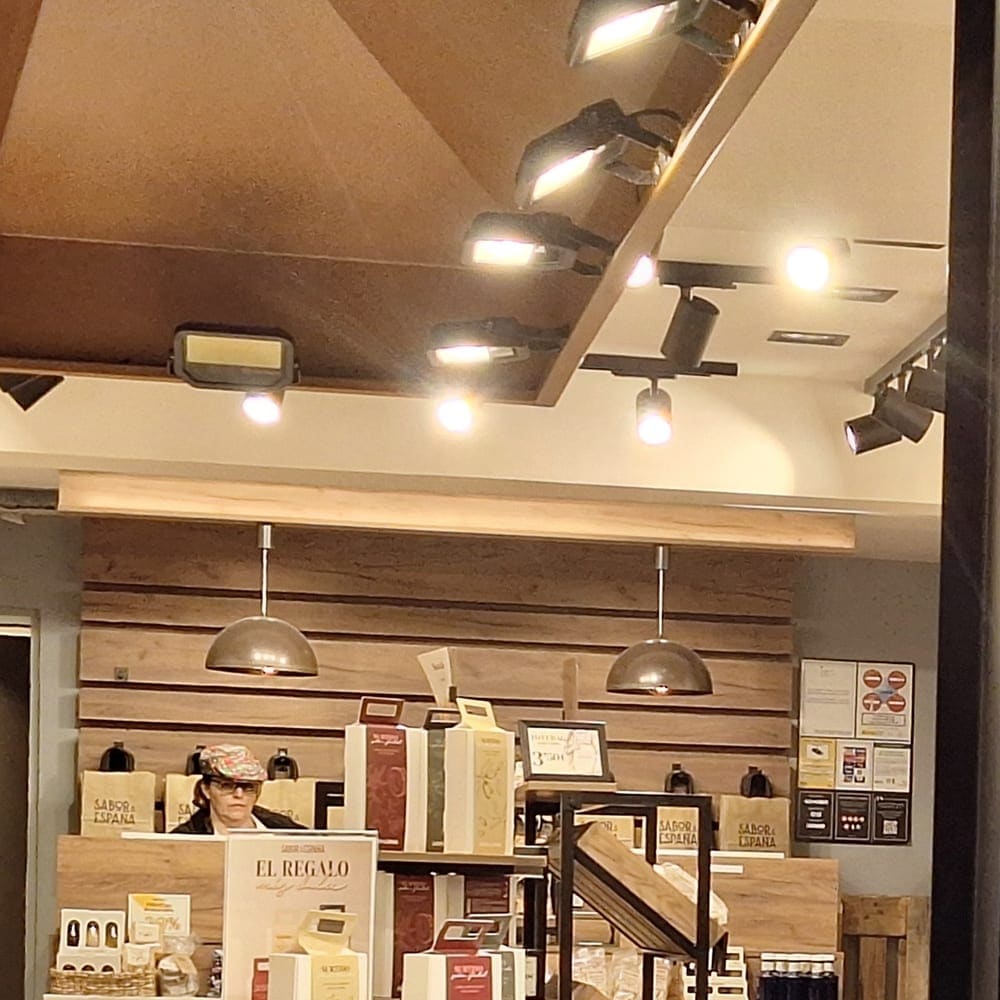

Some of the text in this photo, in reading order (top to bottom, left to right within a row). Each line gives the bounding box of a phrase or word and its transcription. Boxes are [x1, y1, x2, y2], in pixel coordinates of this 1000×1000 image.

[94, 798, 130, 813] SABOR
[659, 819, 692, 832] SABOR
[738, 823, 772, 836] SABOR
[256, 859, 350, 877] EL REGALO
